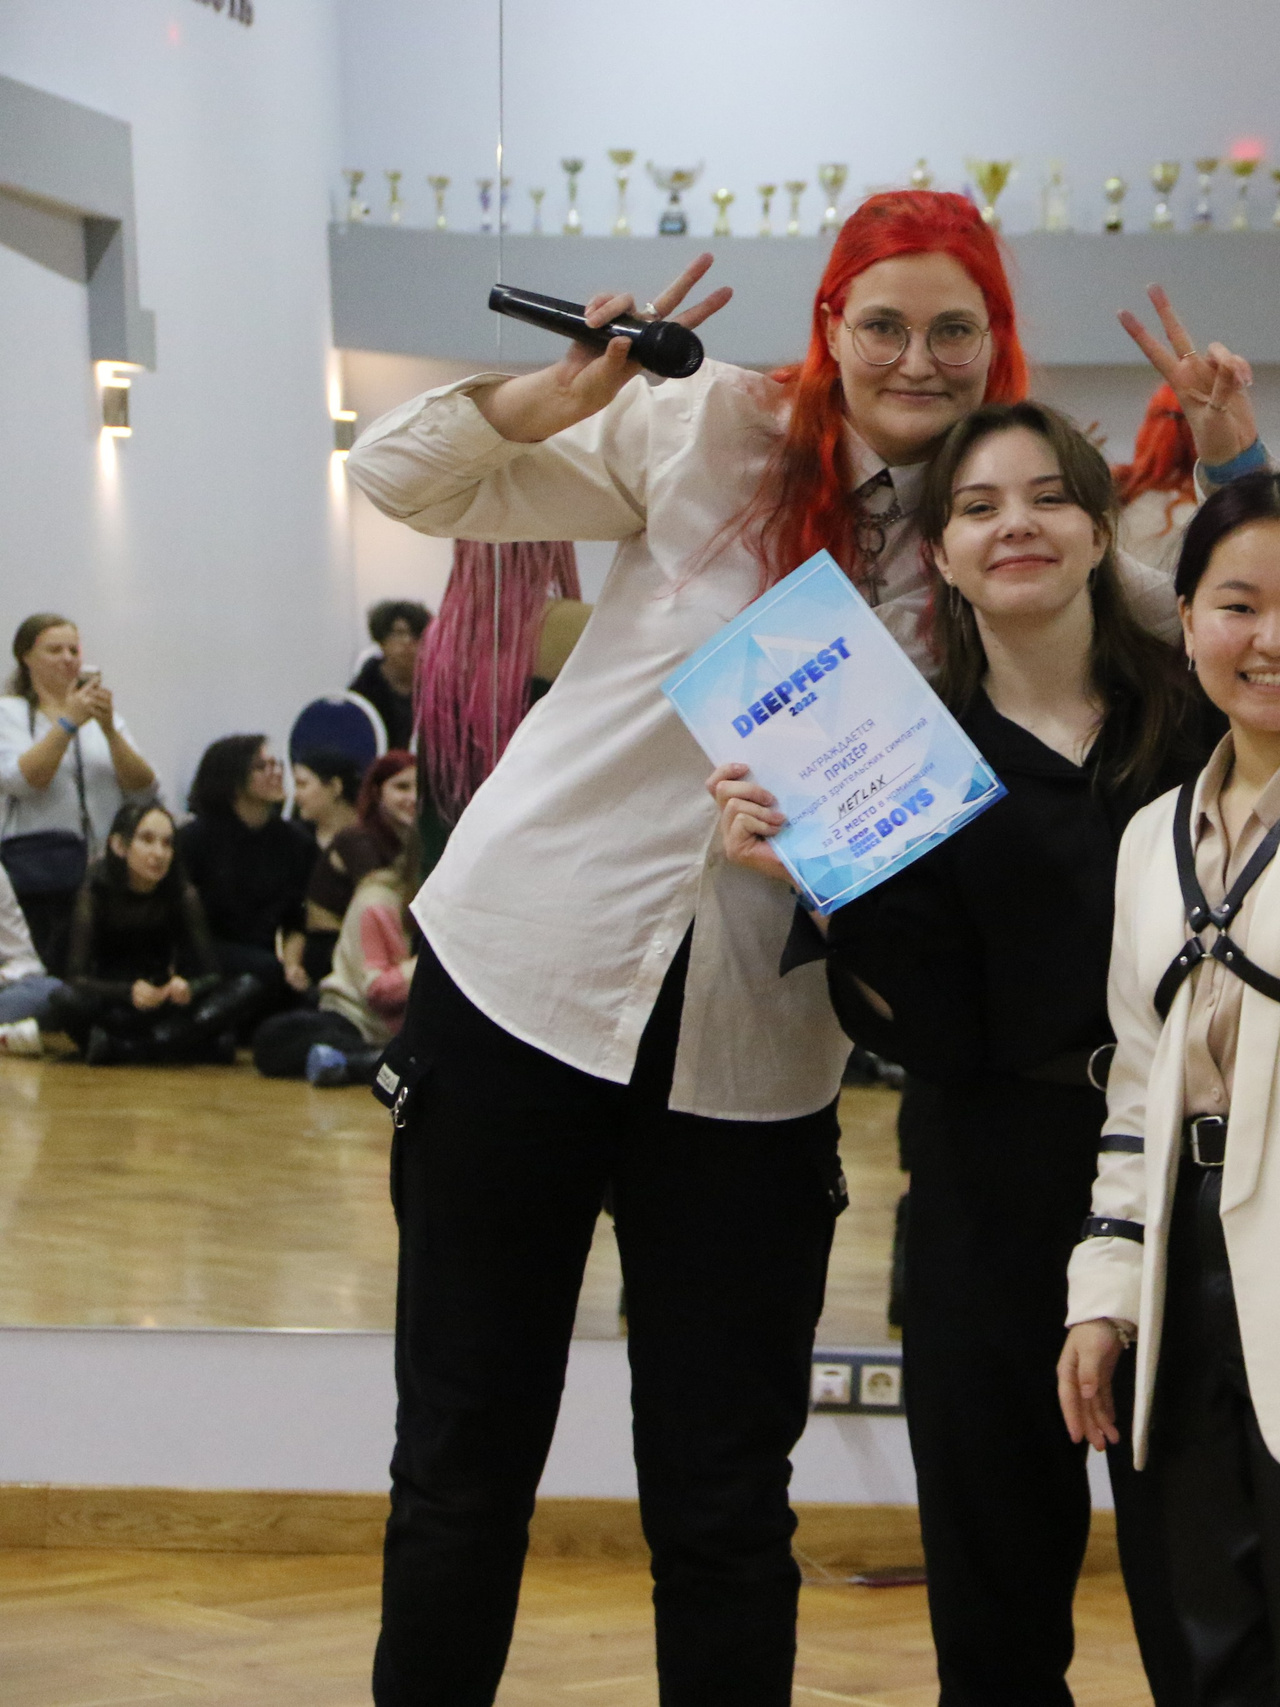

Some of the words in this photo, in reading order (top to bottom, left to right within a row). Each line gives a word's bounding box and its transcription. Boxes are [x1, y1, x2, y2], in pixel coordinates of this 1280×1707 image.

[731, 636, 851, 739] DEEPFEST
[788, 692, 818, 717] 2022
[799, 718, 876, 780] НАГРАЖДАЕТСЯ
[828, 752, 885, 798] зрительских
[885, 717, 928, 754] симпатий
[832, 828, 843, 840] 2
[844, 805, 877, 832] место
[874, 788, 935, 838] BOYS
